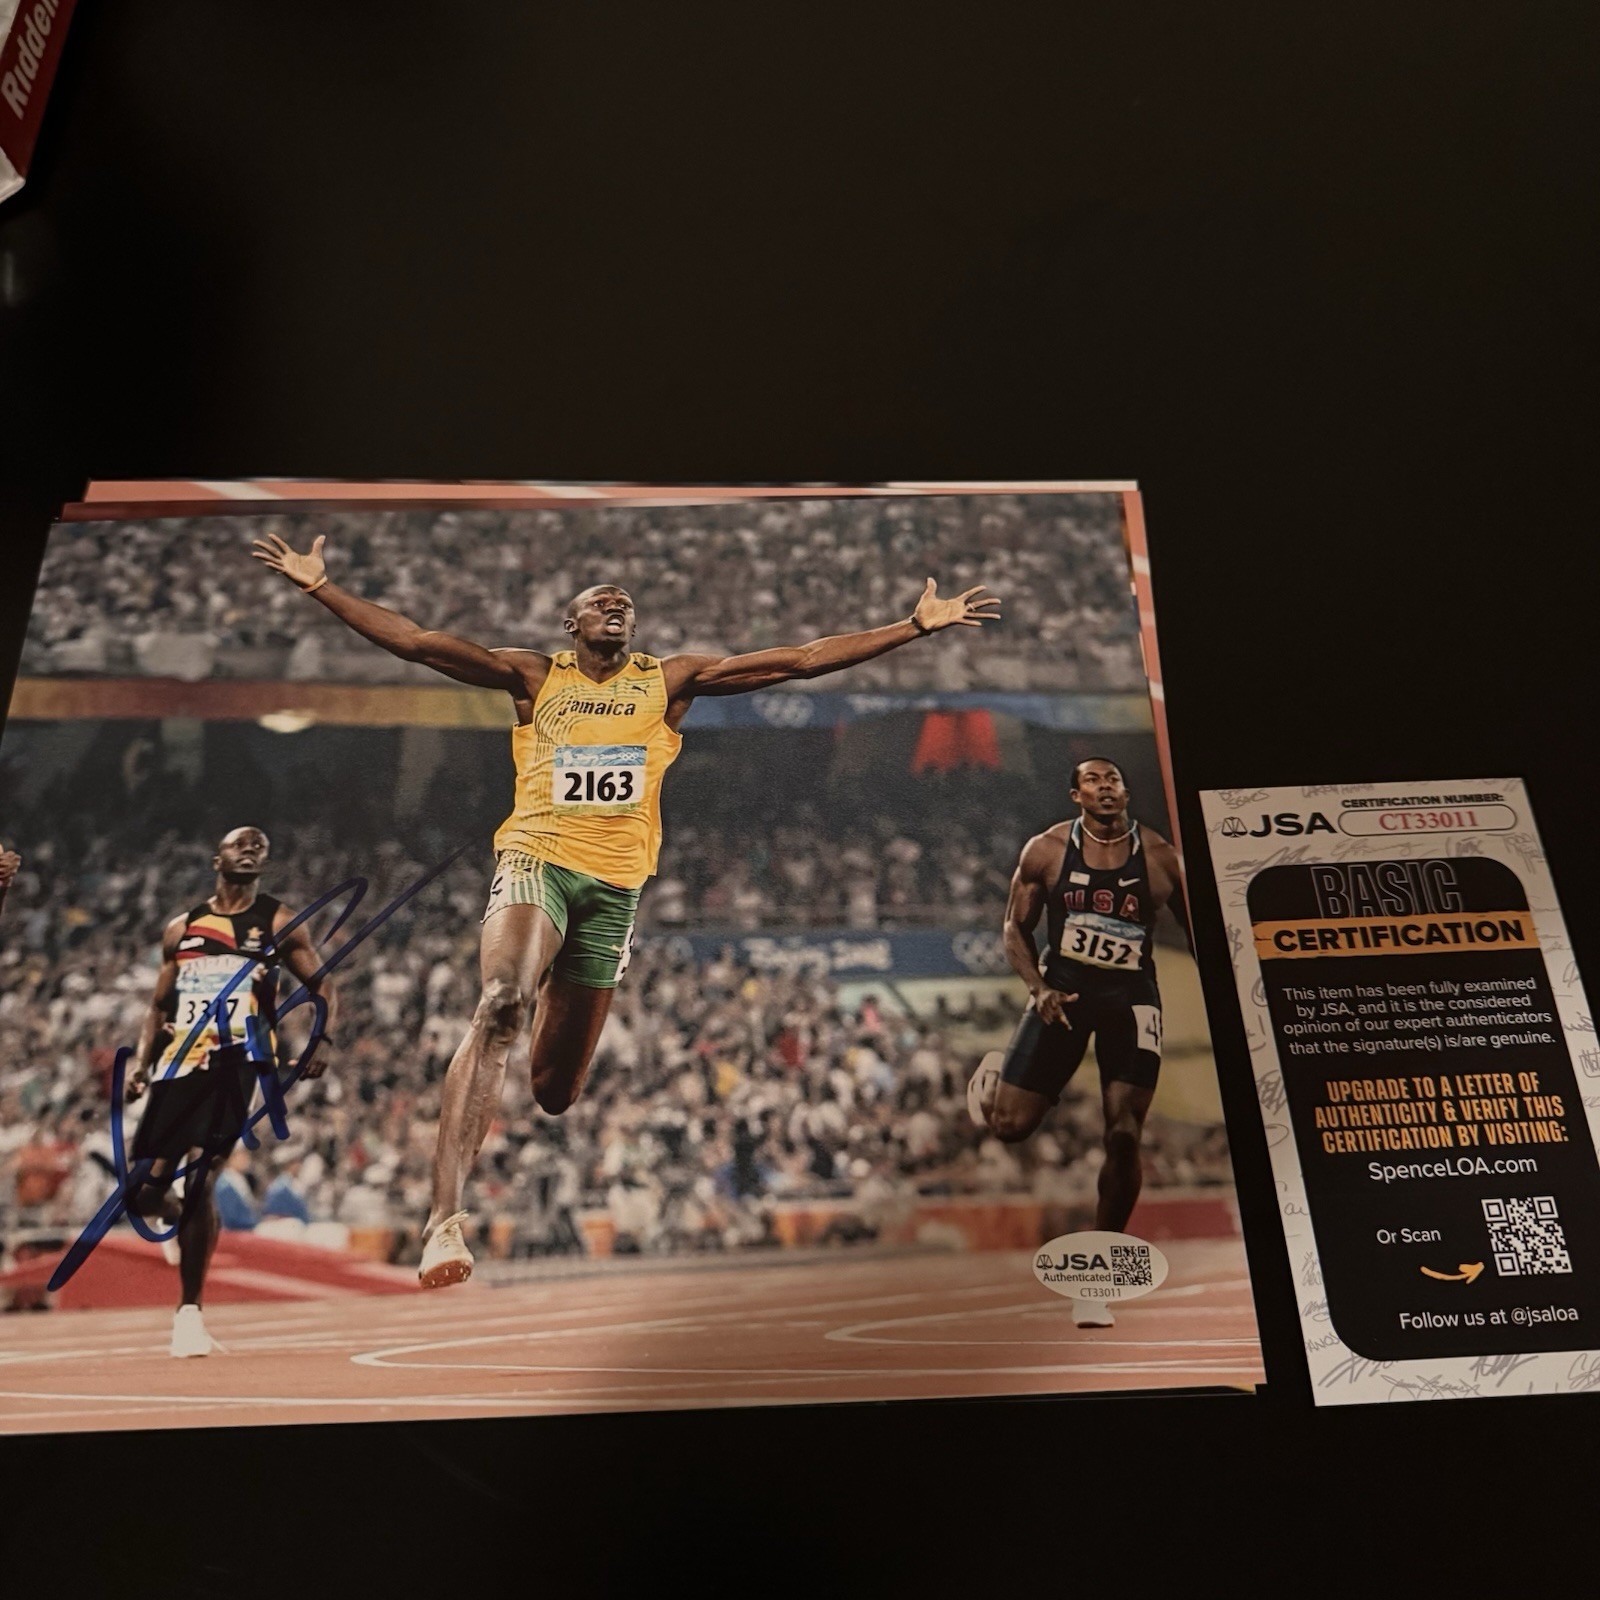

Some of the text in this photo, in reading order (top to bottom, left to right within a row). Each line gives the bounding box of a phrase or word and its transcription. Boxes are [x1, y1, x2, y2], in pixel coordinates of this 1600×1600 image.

[558, 696, 636, 716] jamaica
[564, 771, 634, 801] 2163
[1341, 792, 1504, 808] CERTIFICATION NUMBER:
[1249, 812, 1338, 838] JSA
[1378, 810, 1479, 831] CT33011
[1310, 860, 1463, 919] BASIC
[1063, 889, 1140, 921] USA
[1071, 928, 1133, 965] 3152
[1273, 920, 1525, 952] CERTIFICATION
[1282, 977, 1537, 1001] This item has been fully examined
[1296, 994, 1532, 1020] by JSA, and it is the considered
[1283, 1021, 1341, 1036] opinion
[1344, 1018, 1360, 1032] of
[1364, 1019, 1390, 1031] our
[1393, 1015, 1443, 1031] expert
[1446, 1011, 1553, 1028] authenticators
[1289, 1031, 1556, 1056] that the signature(s) is/are genuine.
[1326, 1071, 1540, 1103] UPGRADE TO A LETTER OF
[1315, 1095, 1565, 1129] AUTHENTICITY & VERIFY THIS
[1322, 1120, 1569, 1154] CERTIFICATION BY VISITING:
[1368, 1156, 1539, 1184] SpenceLOA.com
[1376, 1228, 1442, 1245] Or Scan
[1054, 1253, 1109, 1271] JSA
[1043, 1272, 1112, 1282] Authenticated
[1080, 1287, 1121, 1298] CT33011
[1399, 1305, 1580, 1330] Follow us at @jsaloa
